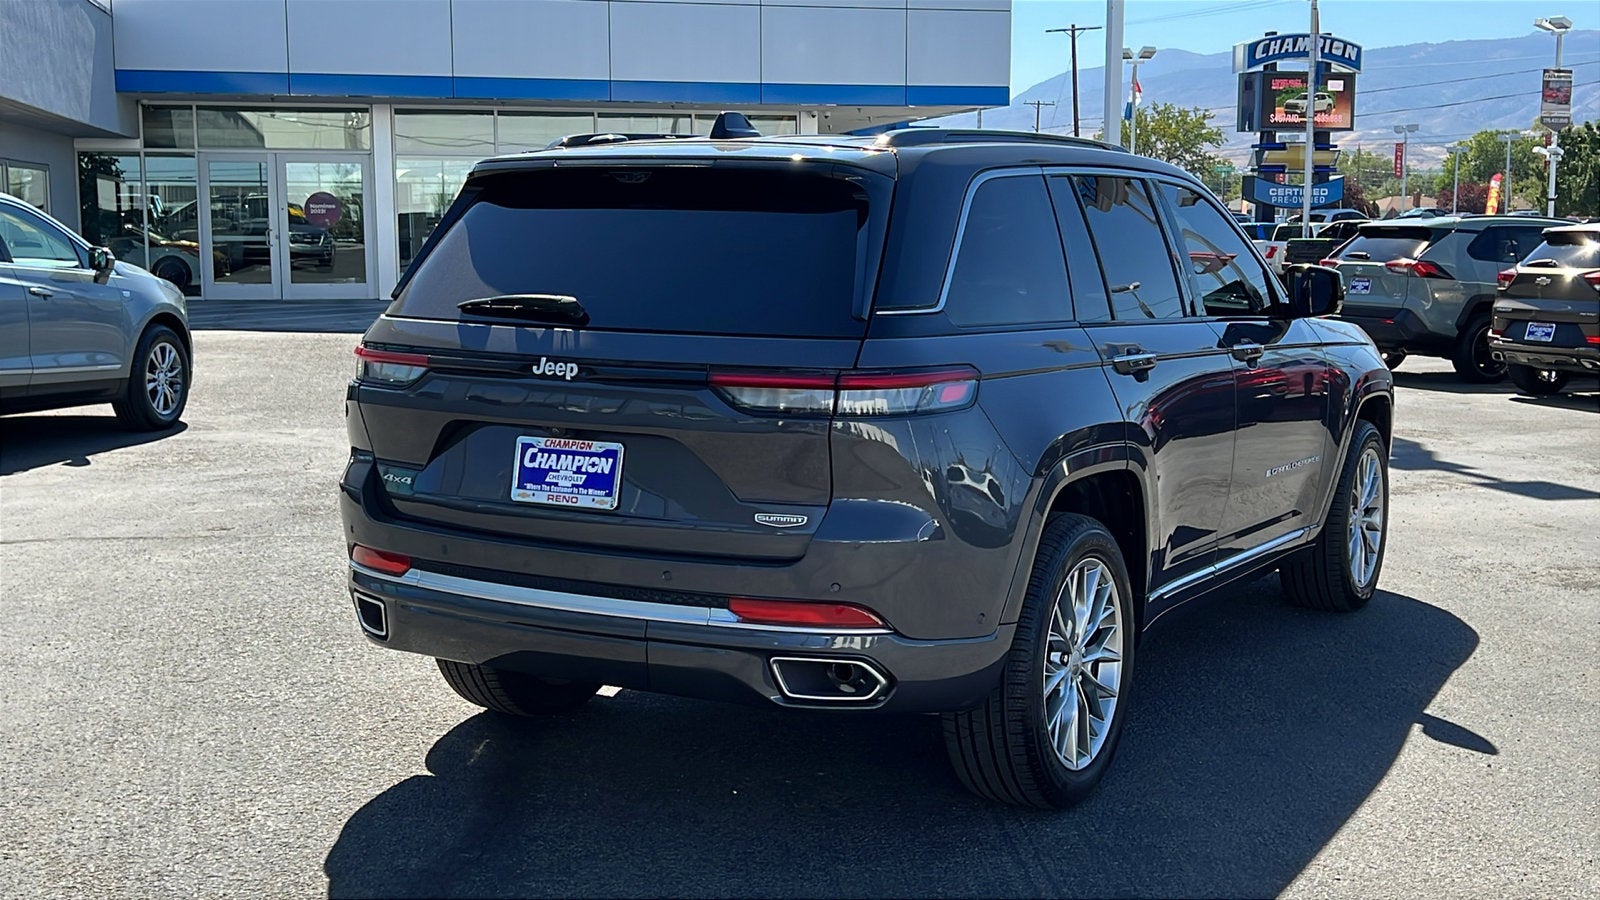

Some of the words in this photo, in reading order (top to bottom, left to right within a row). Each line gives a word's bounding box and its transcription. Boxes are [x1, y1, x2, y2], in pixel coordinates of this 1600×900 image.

[1255, 37, 1358, 60] CHAMION
[1269, 187, 1329, 196] CERTIED
[532, 356, 579, 381] Jeep
[544, 438, 594, 451] CHAMPION
[523, 447, 613, 474] CHAMPION
[383, 473, 412, 485] 4x4
[548, 474, 584, 483] CHEVROLET
[541, 483, 550, 491] The
[578, 487, 588, 495] The
[546, 494, 579, 504] RENO
[757, 515, 804, 523] SUMMIT
